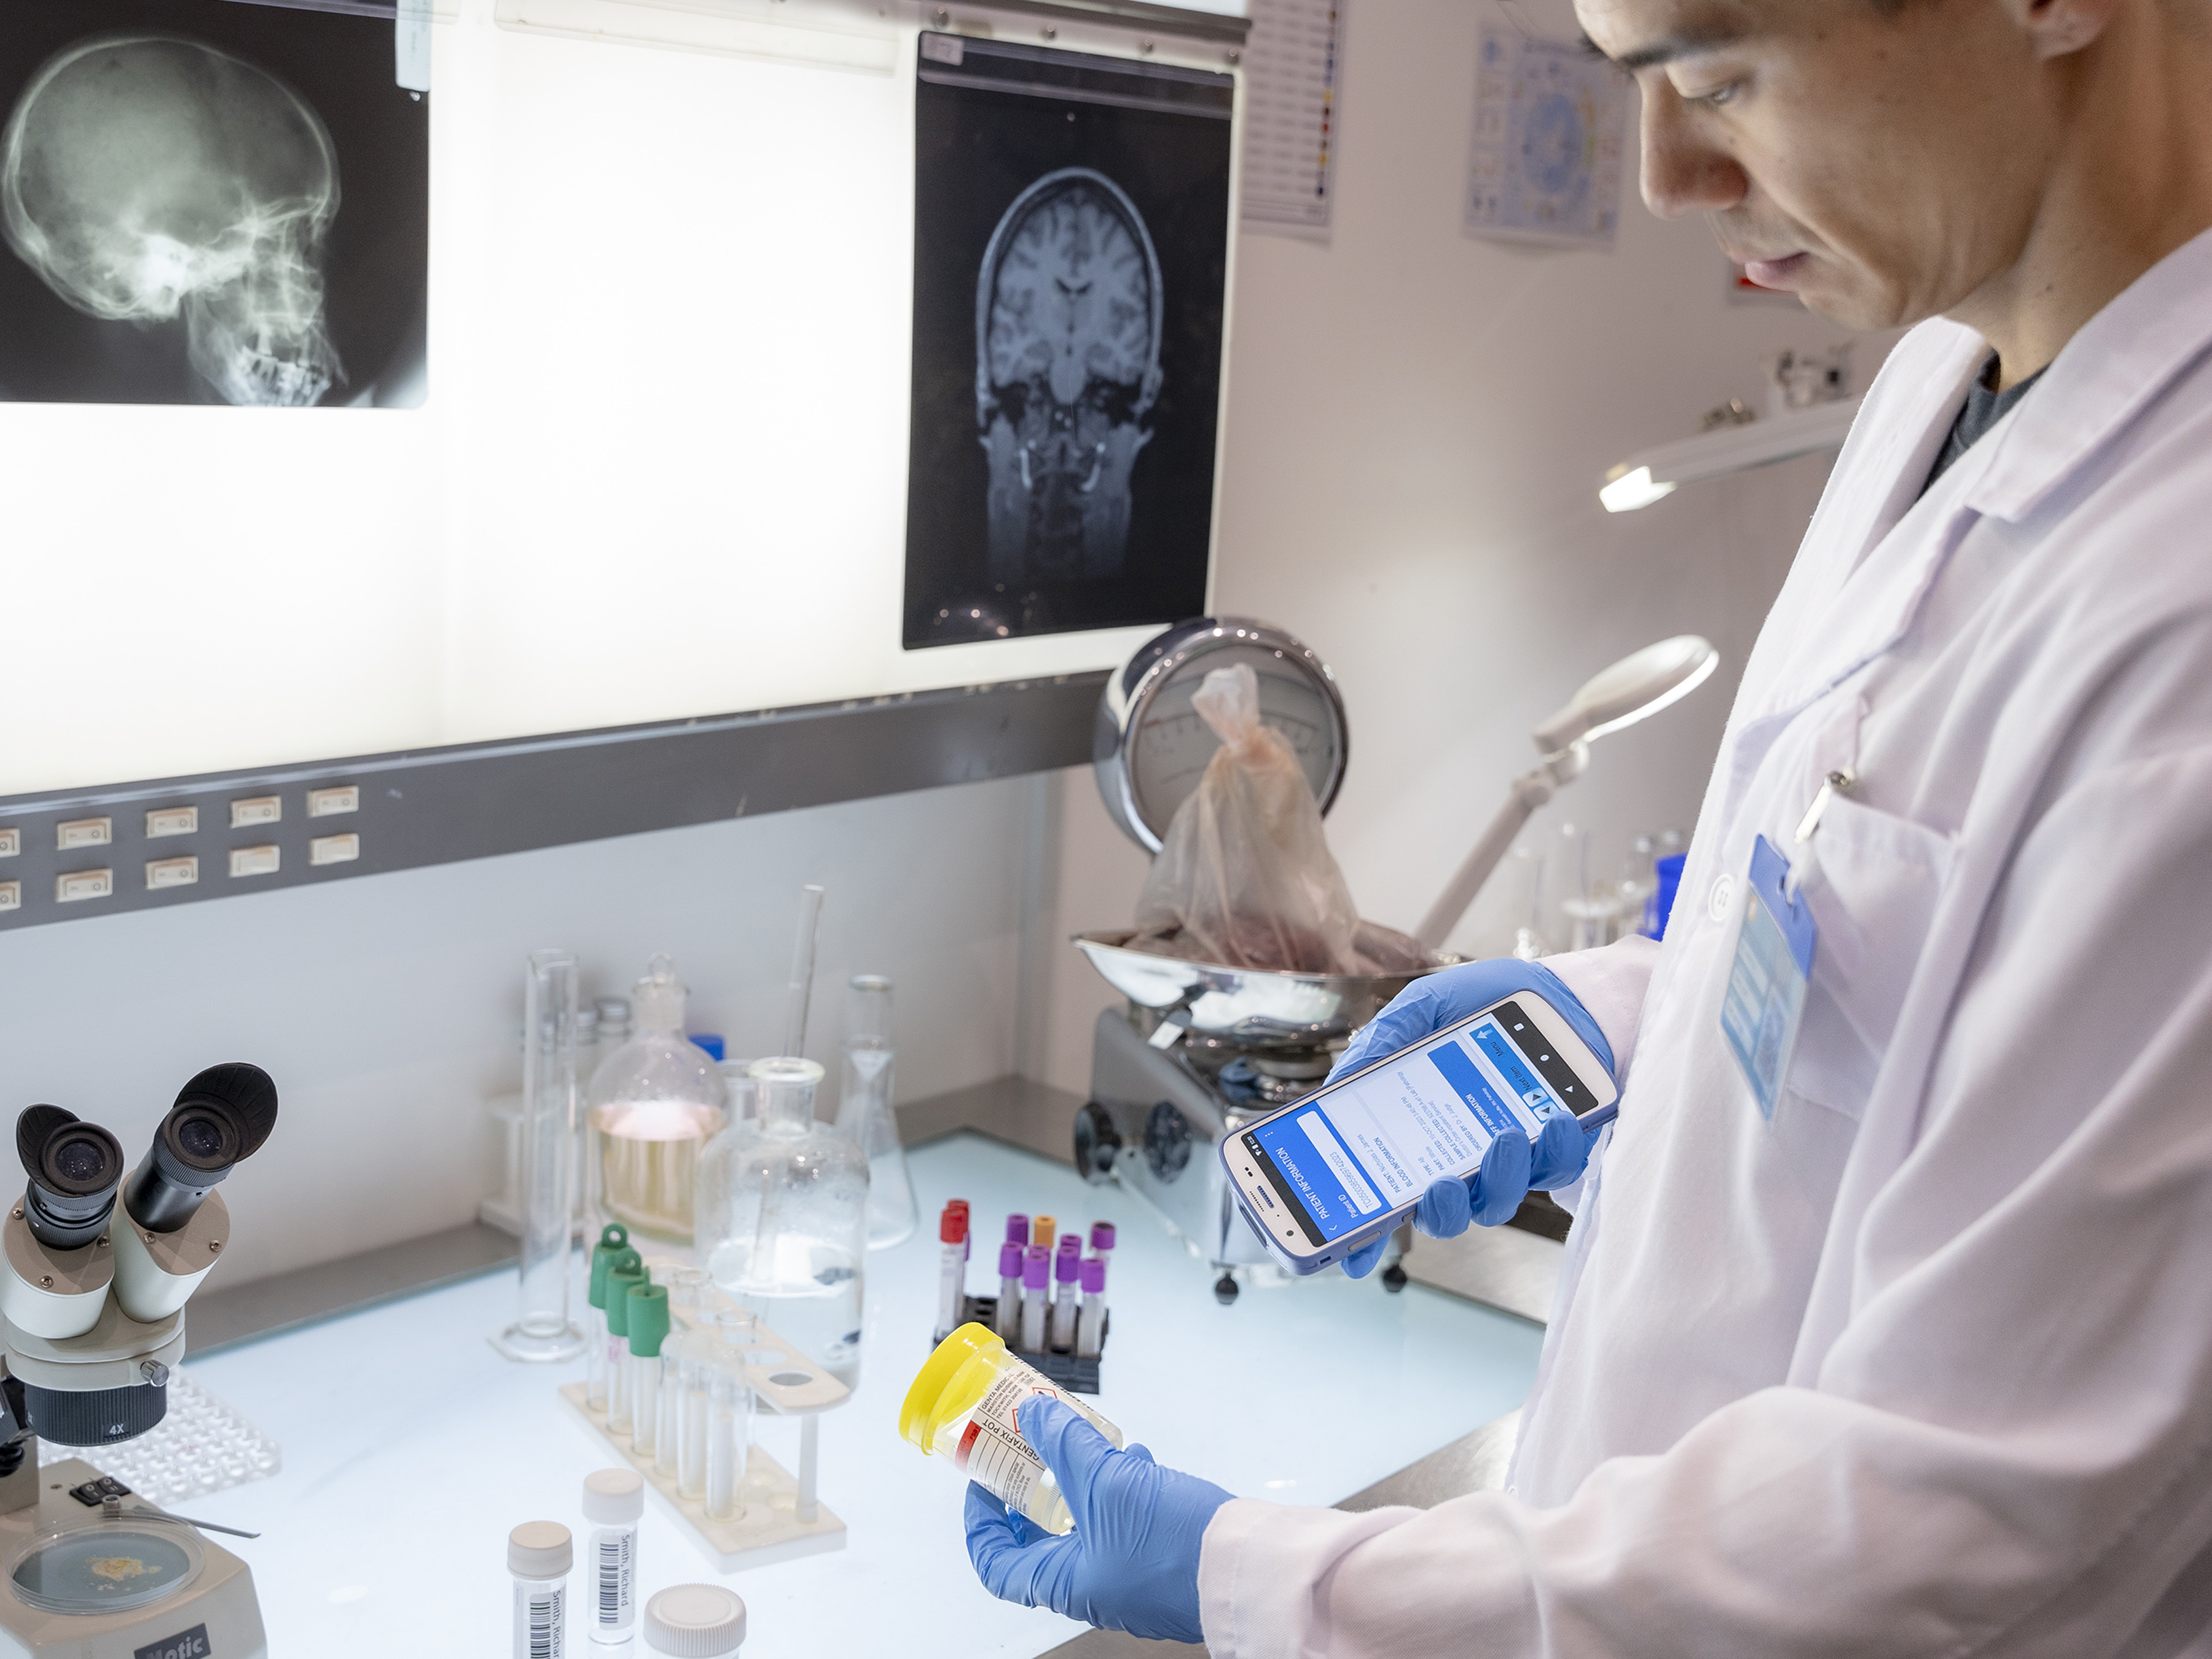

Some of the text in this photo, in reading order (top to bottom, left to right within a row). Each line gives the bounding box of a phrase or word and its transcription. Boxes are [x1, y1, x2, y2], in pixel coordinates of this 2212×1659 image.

[1489, 1041, 1504, 1056] Menu
[1509, 1065, 1532, 1090] Next Item
[1465, 1093, 1494, 1126] INFORMATION
[1355, 1134, 1370, 1149] James
[1431, 1118, 1453, 1143] COLLECTED:
[1464, 1131, 1483, 1151] ORDERED
[1373, 1136, 1413, 1187] BLOOD INFORMATION
[1433, 1139, 1456, 1165] COLLECTED:
[1449, 1142, 1465, 1160] SAMPLE
[1369, 1153, 1386, 1172] Nicholas
[1275, 1147, 1330, 1219] PATIENT INFORMATION
[1382, 1171, 1402, 1193] PATIENT:
[1342, 1199, 1359, 1218] Patient
[980, 1390, 997, 1409] GENTA
[984, 1392, 1004, 1413] MARSTON
[109, 1423, 125, 1435] 4X
[982, 1418, 1040, 1461] GENTAFIX POT
[621, 1534, 630, 1607] Smith, Richard
[552, 1590, 562, 1625] Smith,
